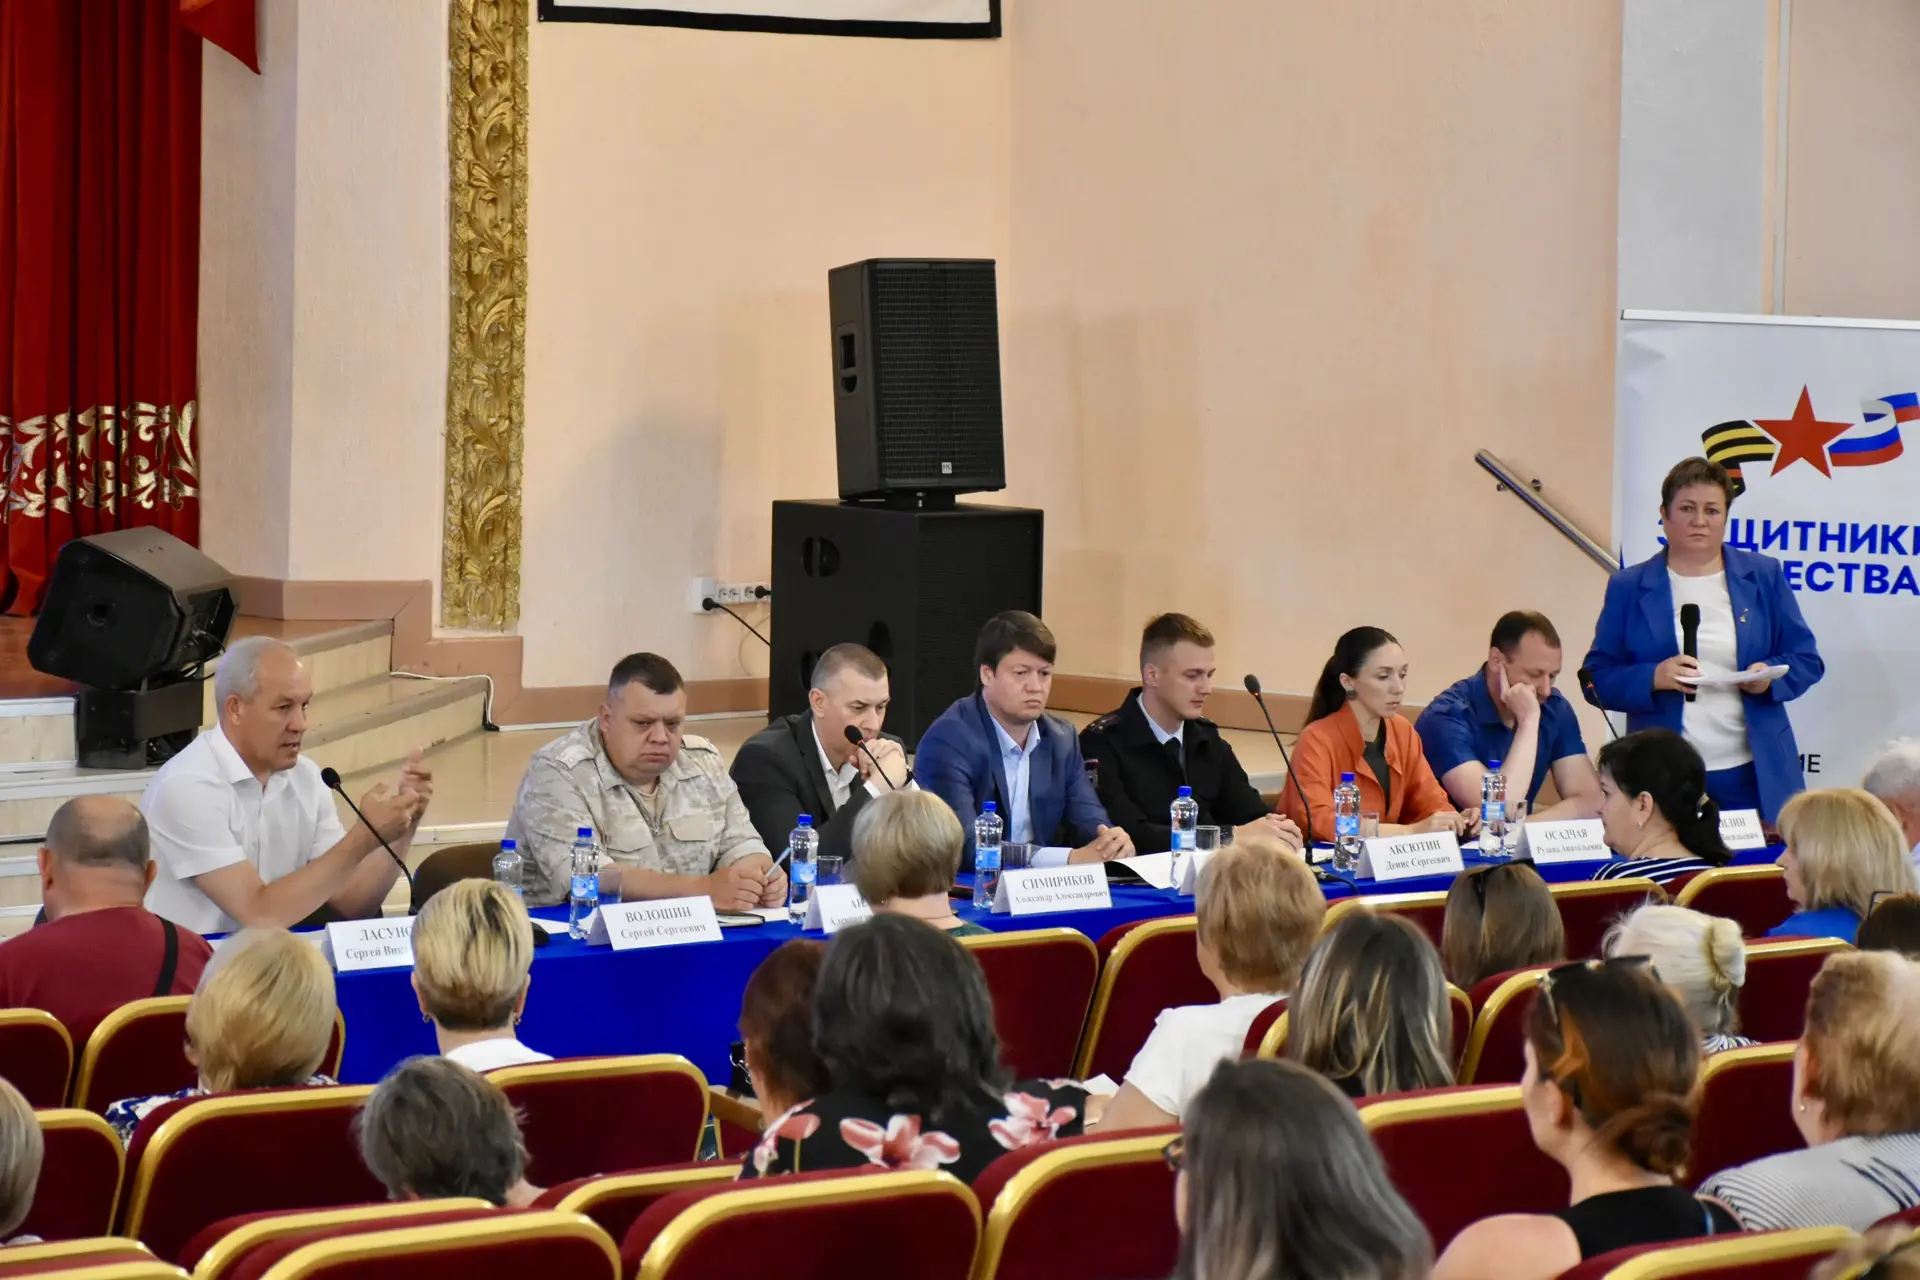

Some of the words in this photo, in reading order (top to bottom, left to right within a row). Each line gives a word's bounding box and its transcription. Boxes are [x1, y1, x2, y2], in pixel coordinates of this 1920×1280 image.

[1657, 517, 1920, 556] ЩИТНИК
[1783, 559, 1920, 596] ЕСТВА
[1544, 829, 1588, 840] ОСАДЧАЯ
[1389, 839, 1441, 855] АКСЮТИН
[1386, 860, 1410, 871] Денис
[1411, 856, 1451, 868] Сергеевич
[1022, 874, 1095, 890] СИМИРИКОВ
[625, 906, 692, 923] ВОЛОШИН
[621, 928, 655, 940] Сергей
[656, 923, 707, 937] Сергеевич
[346, 948, 381, 960] Сергей
